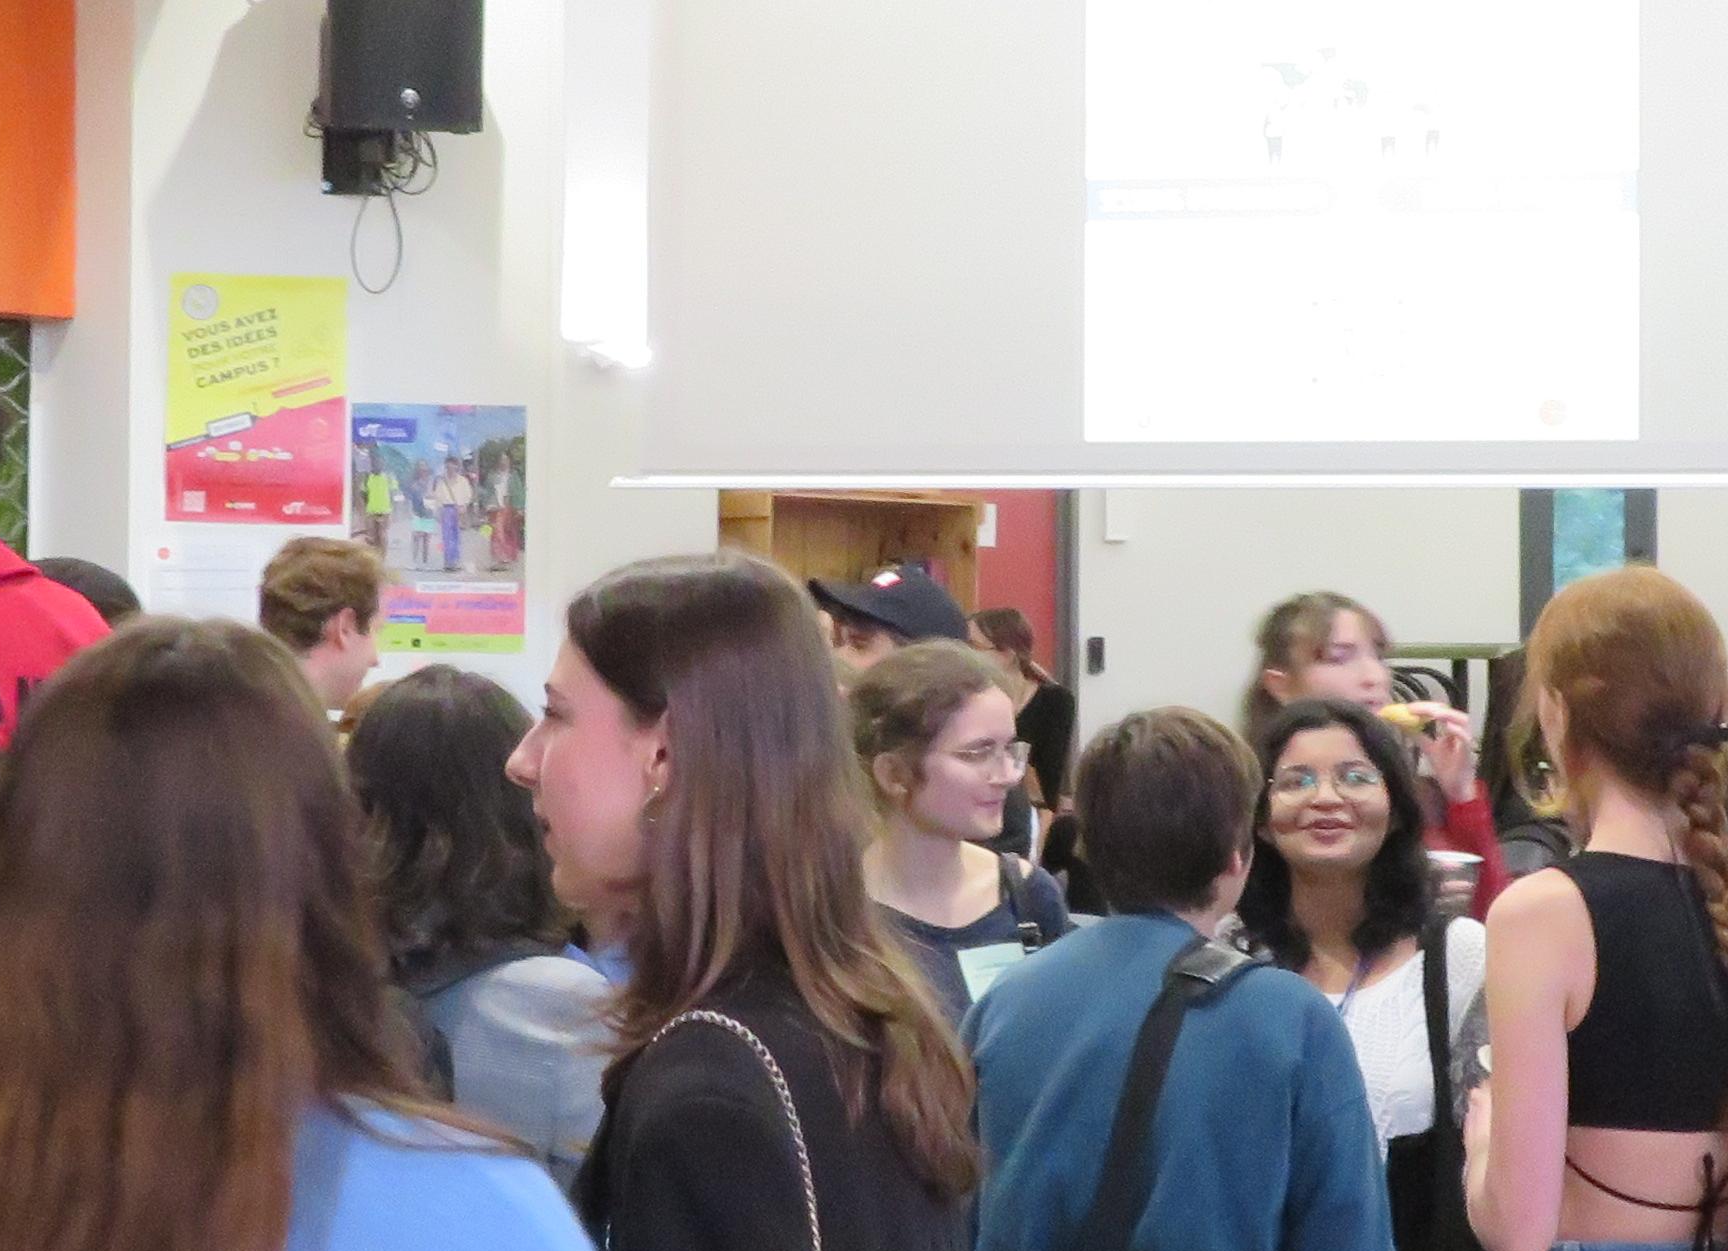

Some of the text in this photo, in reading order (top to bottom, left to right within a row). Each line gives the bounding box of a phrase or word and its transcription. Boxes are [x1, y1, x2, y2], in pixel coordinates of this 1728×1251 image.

[182, 307, 280, 342] VOUS AVEZ
[187, 340, 222, 359] DES
[195, 361, 270, 389] CAMPUS
